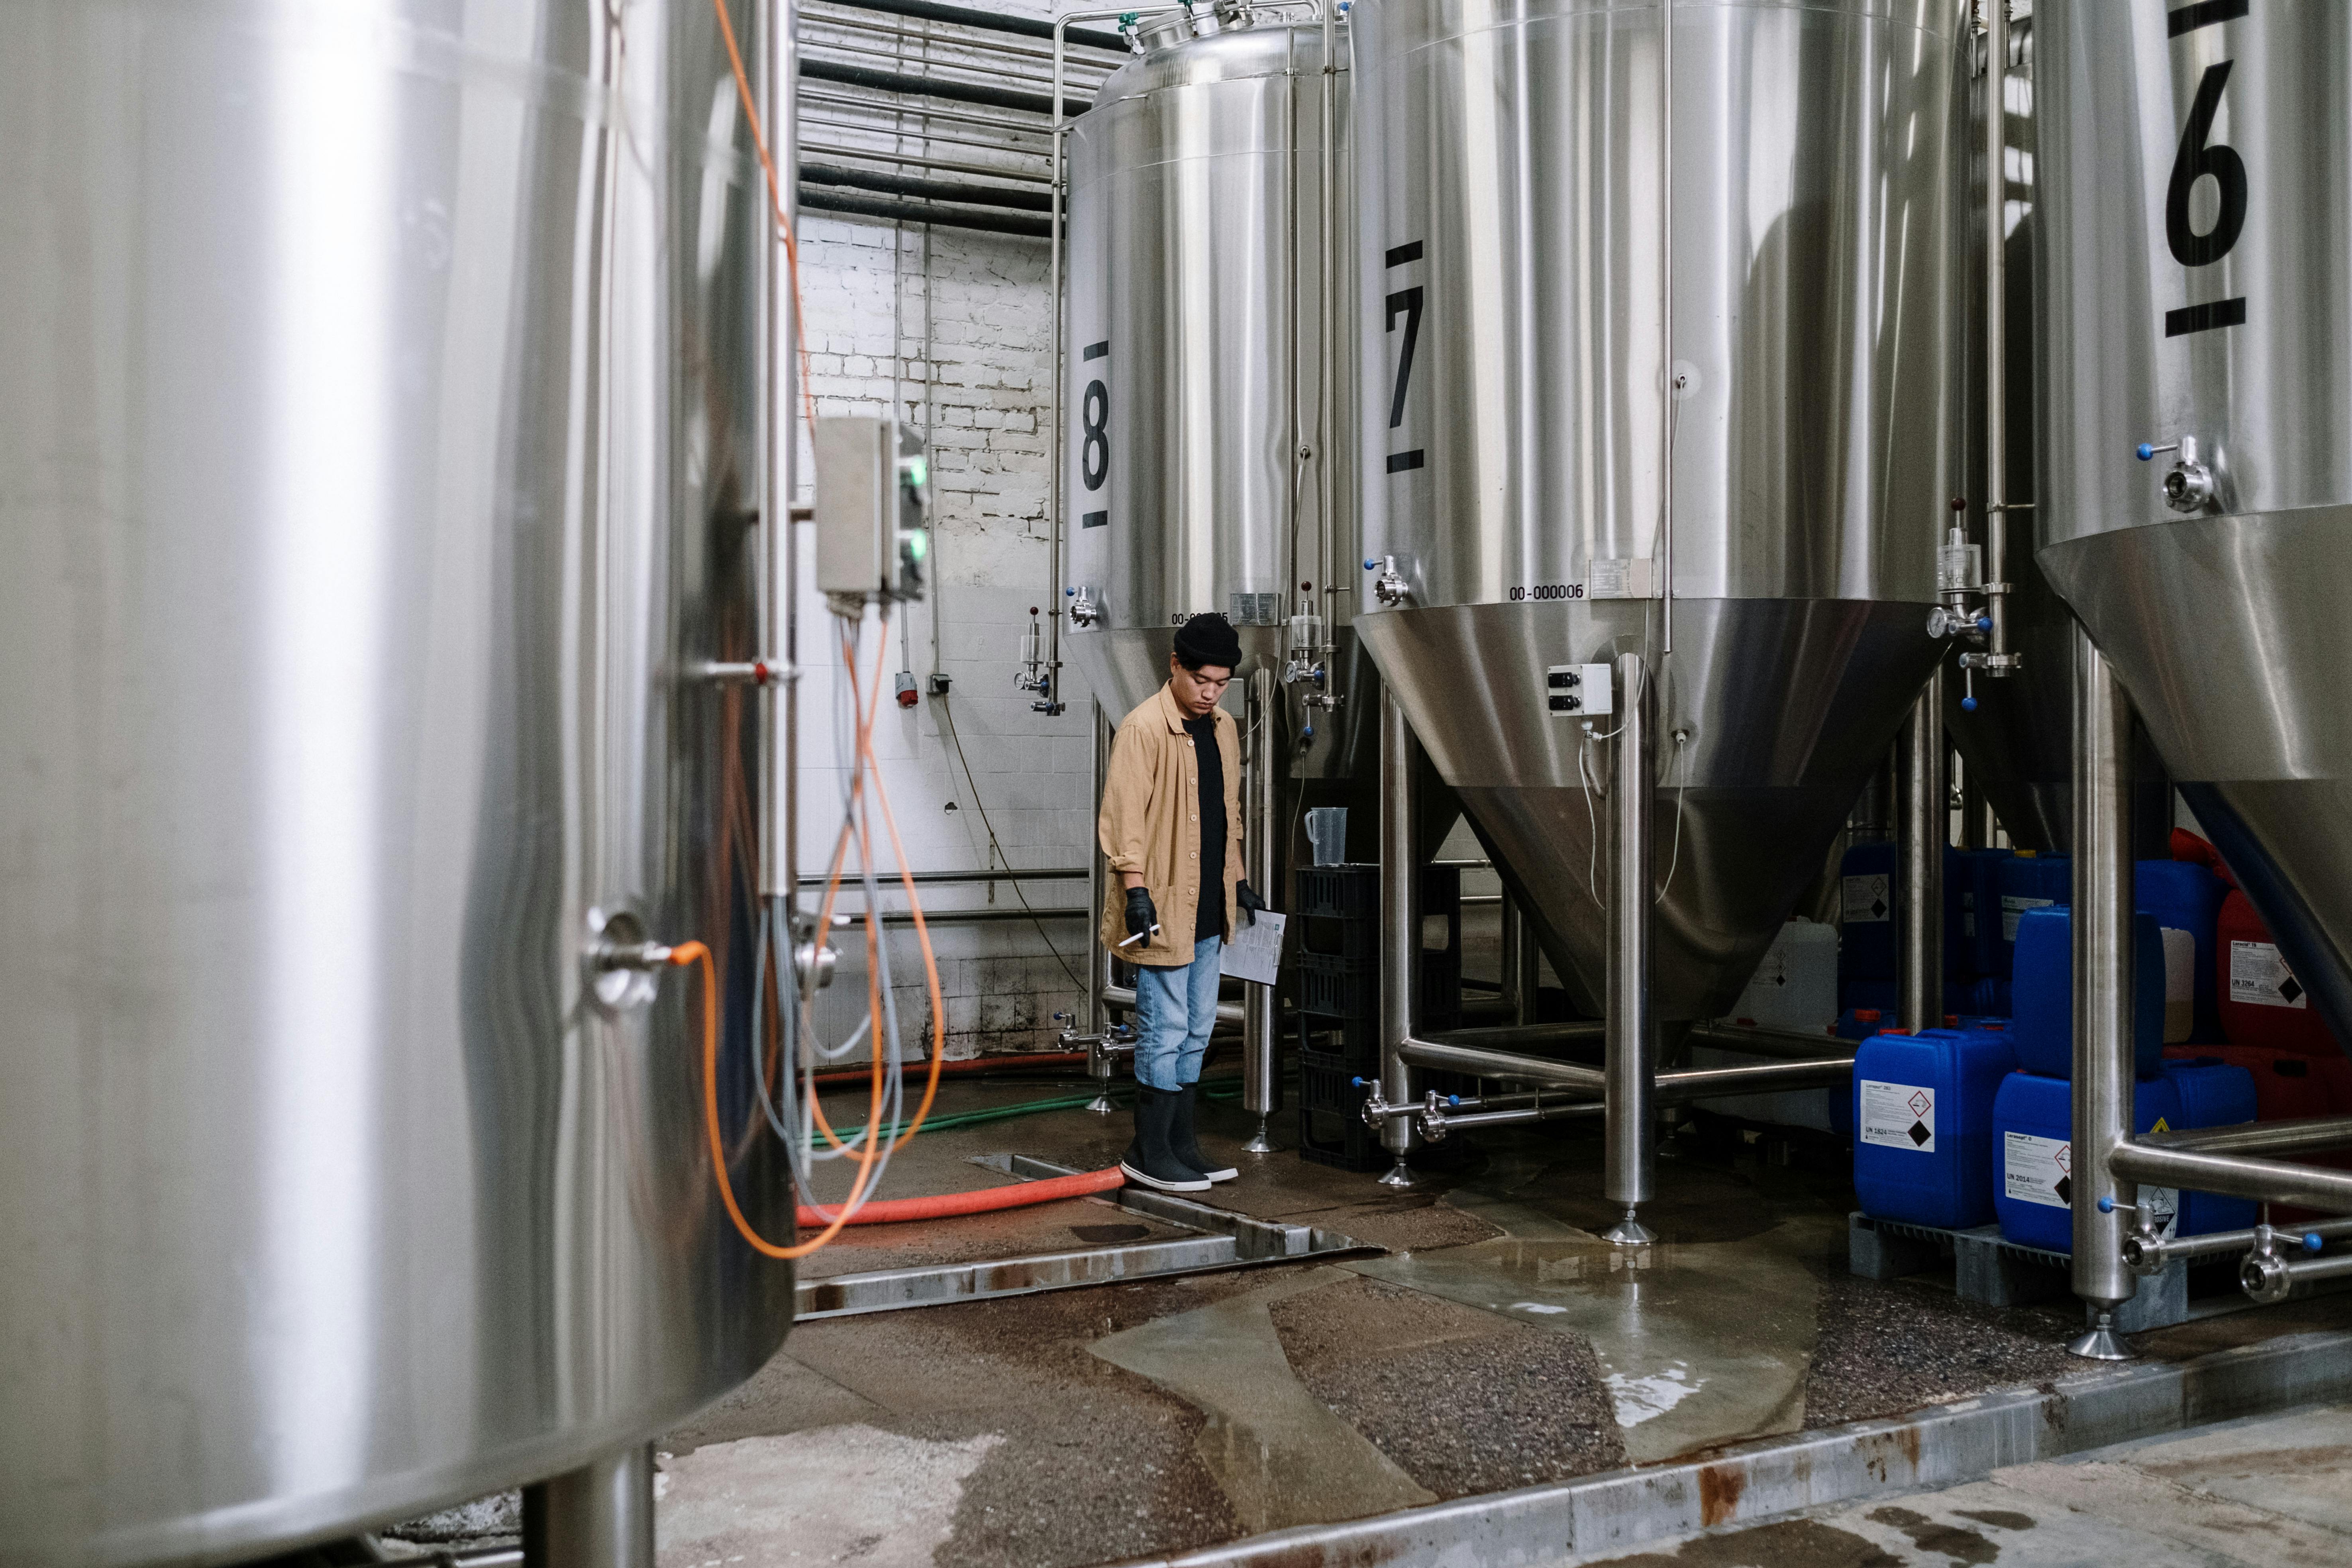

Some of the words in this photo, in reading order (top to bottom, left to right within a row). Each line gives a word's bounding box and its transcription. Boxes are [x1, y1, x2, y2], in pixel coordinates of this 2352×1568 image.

[2166, 59, 2248, 267] 6
[1385, 285, 1424, 429] 7
[1083, 379, 1109, 491] 8
[1510, 584, 1583, 601] 00-000006
